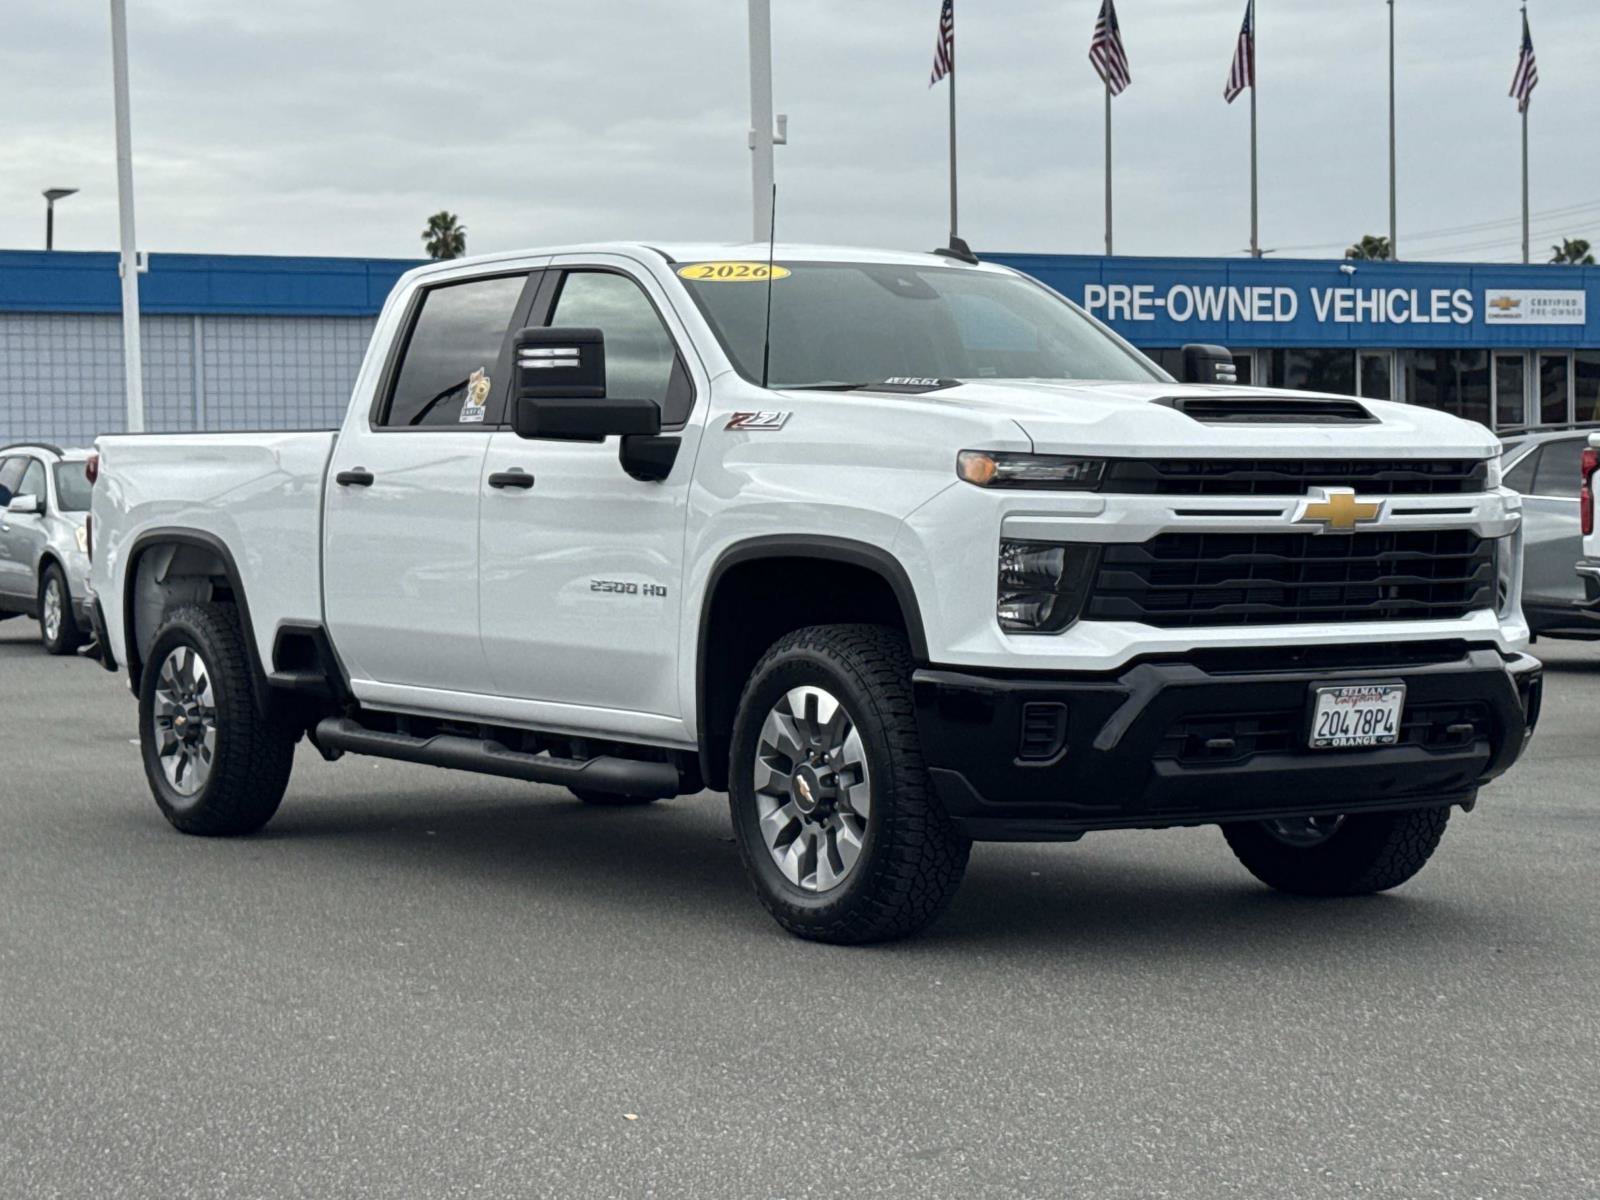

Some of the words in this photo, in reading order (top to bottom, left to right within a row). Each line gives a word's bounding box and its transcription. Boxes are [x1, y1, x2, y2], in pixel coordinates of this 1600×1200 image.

[699, 265, 768, 279] 2026
[1084, 284, 1298, 322] PRE-OWNED
[1310, 287, 1473, 324] VEHICLES
[1530, 298, 1577, 306] CERTIFIED
[1530, 308, 1583, 316] PRE-OWNED
[723, 411, 794, 431] Z71
[590, 580, 638, 594] 2500
[643, 583, 667, 597] HD
[1341, 687, 1384, 697] SELMAN
[1318, 708, 1393, 738] 20478P4
[1332, 736, 1377, 747] ORANGE
